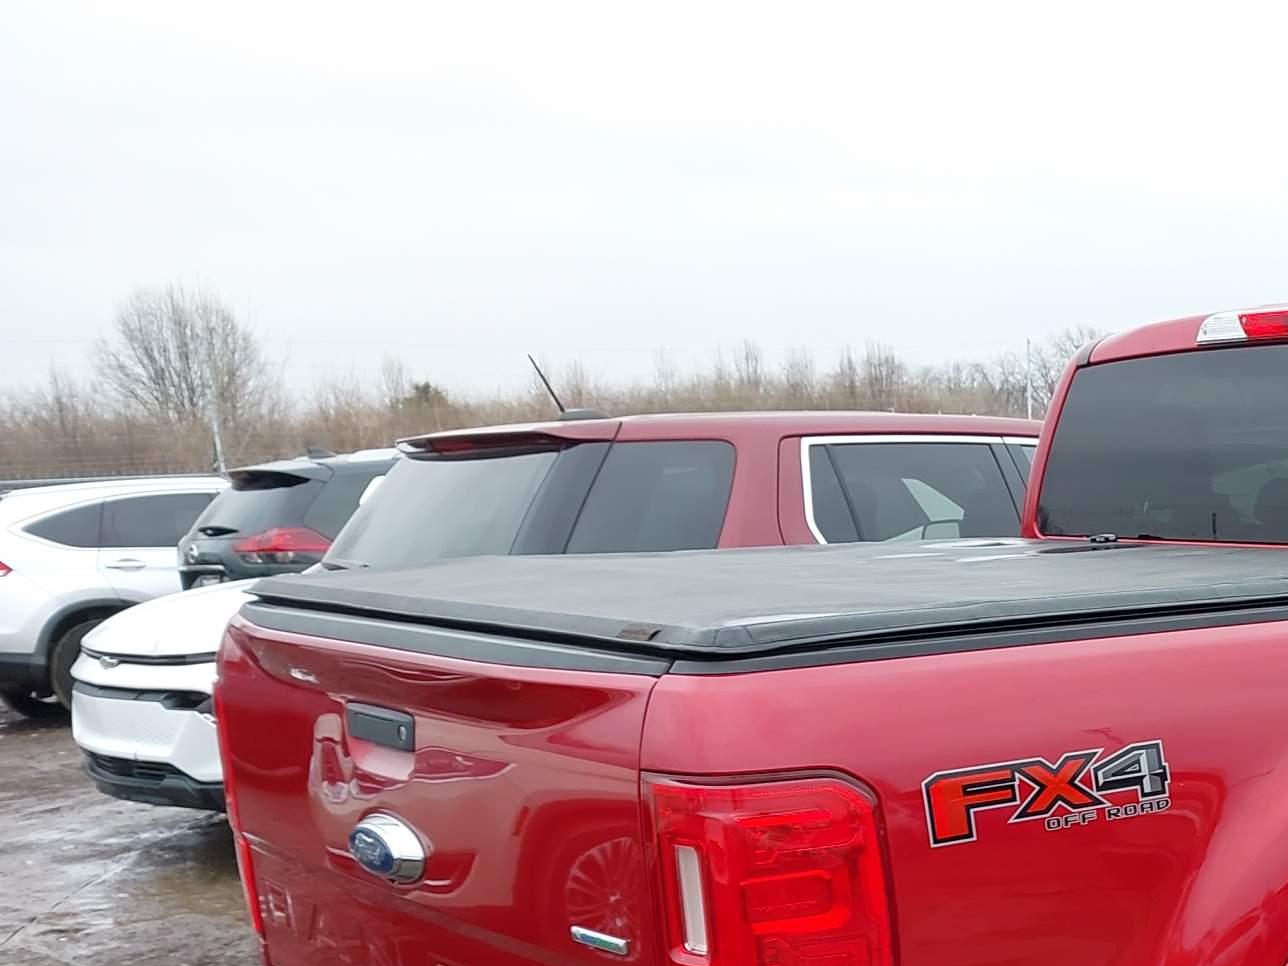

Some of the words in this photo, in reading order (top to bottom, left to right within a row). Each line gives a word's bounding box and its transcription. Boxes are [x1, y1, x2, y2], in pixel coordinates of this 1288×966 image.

[921, 740, 1171, 848] FX4
[1044, 810, 1097, 831] OFF
[1106, 798, 1171, 820] ROAD
